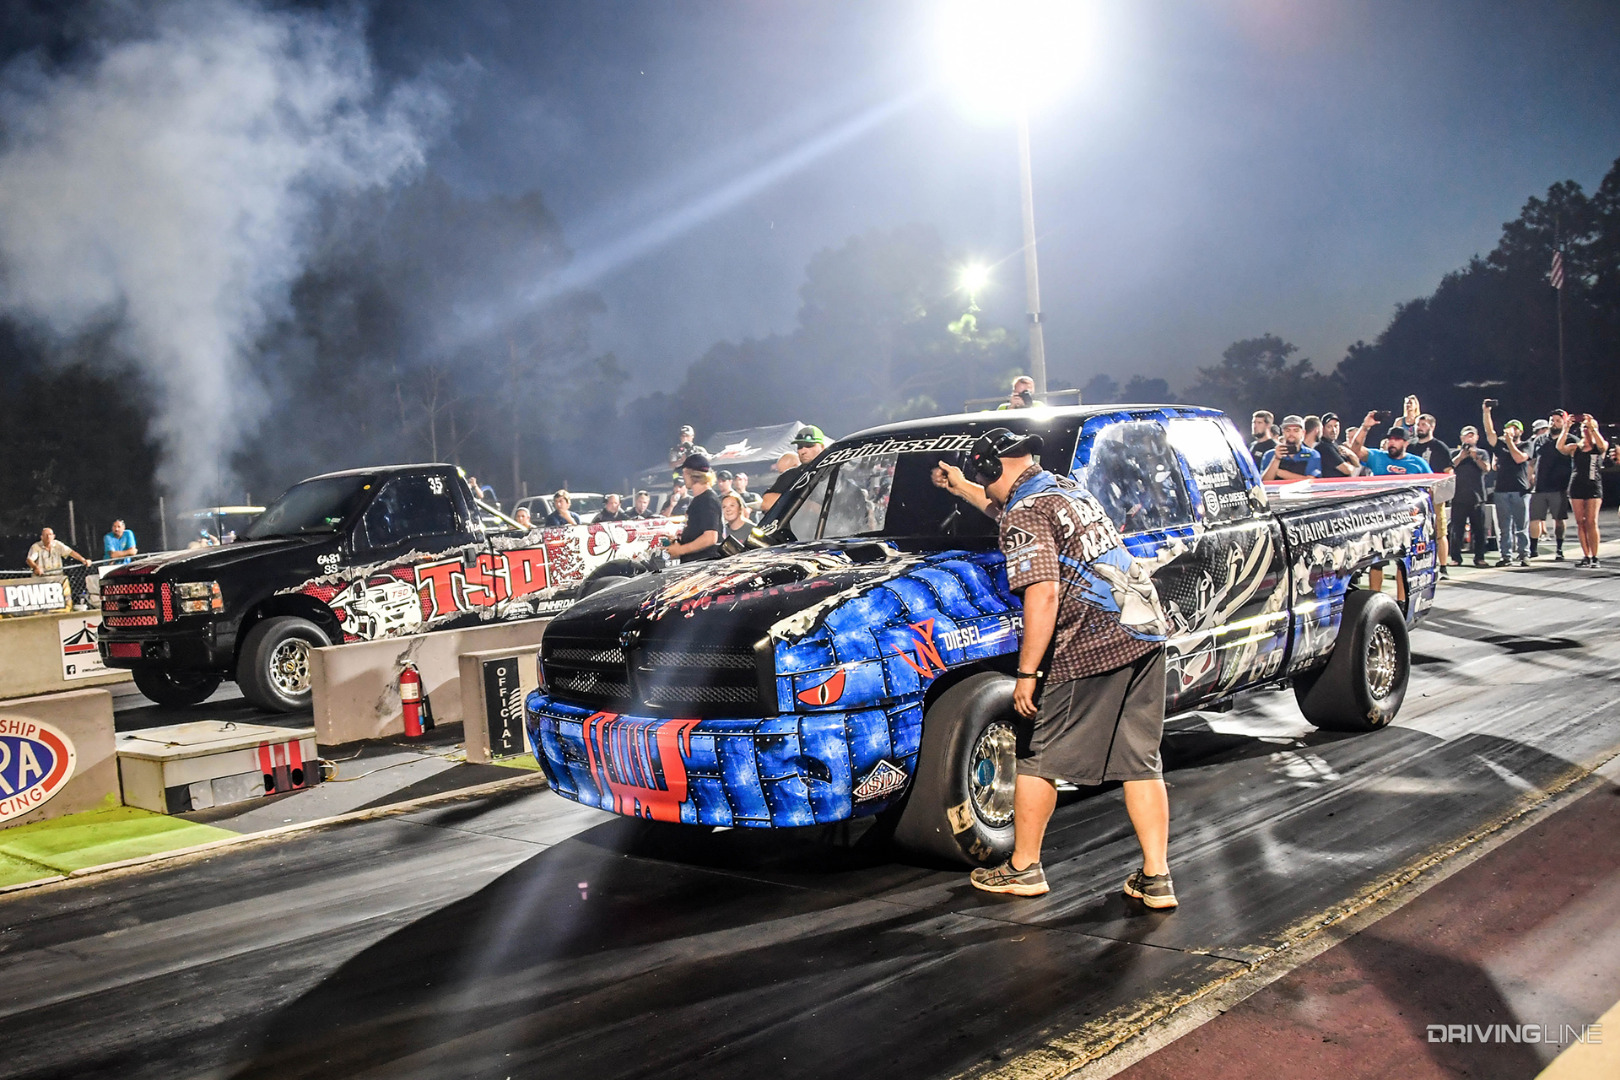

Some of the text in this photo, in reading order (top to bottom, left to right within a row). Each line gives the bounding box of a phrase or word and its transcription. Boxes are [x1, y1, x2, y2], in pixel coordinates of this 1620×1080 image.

[1057, 507, 1075, 539] 5
[5, 582, 65, 607] POWER
[391, 588, 409, 598] TSD
[417, 547, 551, 620] TSD
[937, 625, 981, 652] DIESEL
[496, 667, 512, 749] OFFICIAL
